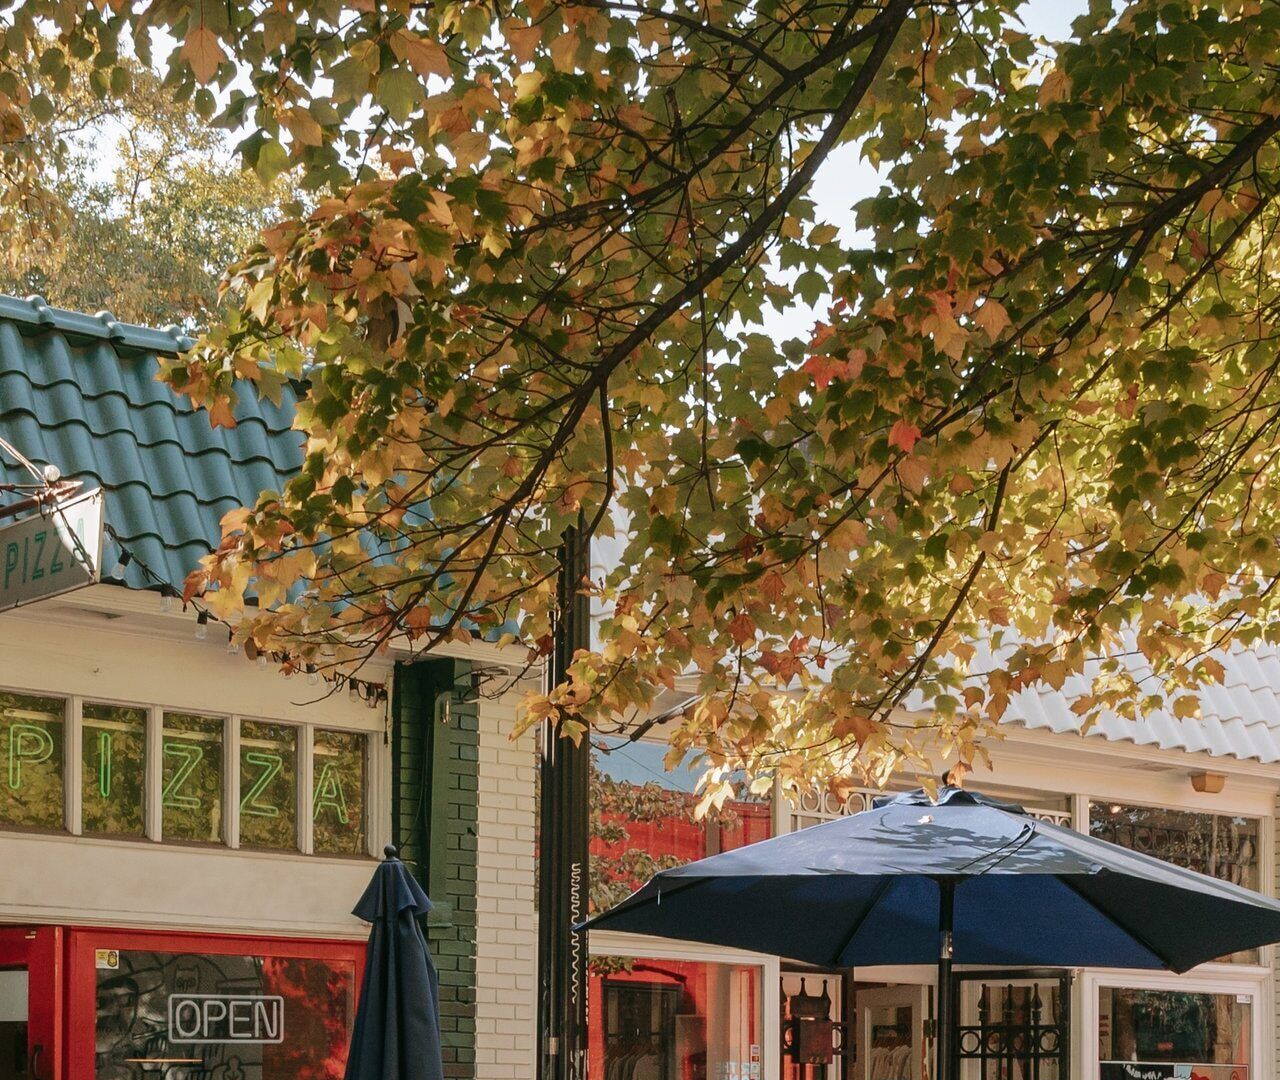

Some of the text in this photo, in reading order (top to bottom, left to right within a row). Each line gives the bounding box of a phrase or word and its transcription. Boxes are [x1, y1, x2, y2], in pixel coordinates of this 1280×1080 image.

[4, 516, 86, 590] PIZZA
[8, 723, 349, 825] PIZZA
[174, 1000, 277, 1039] OPEN
